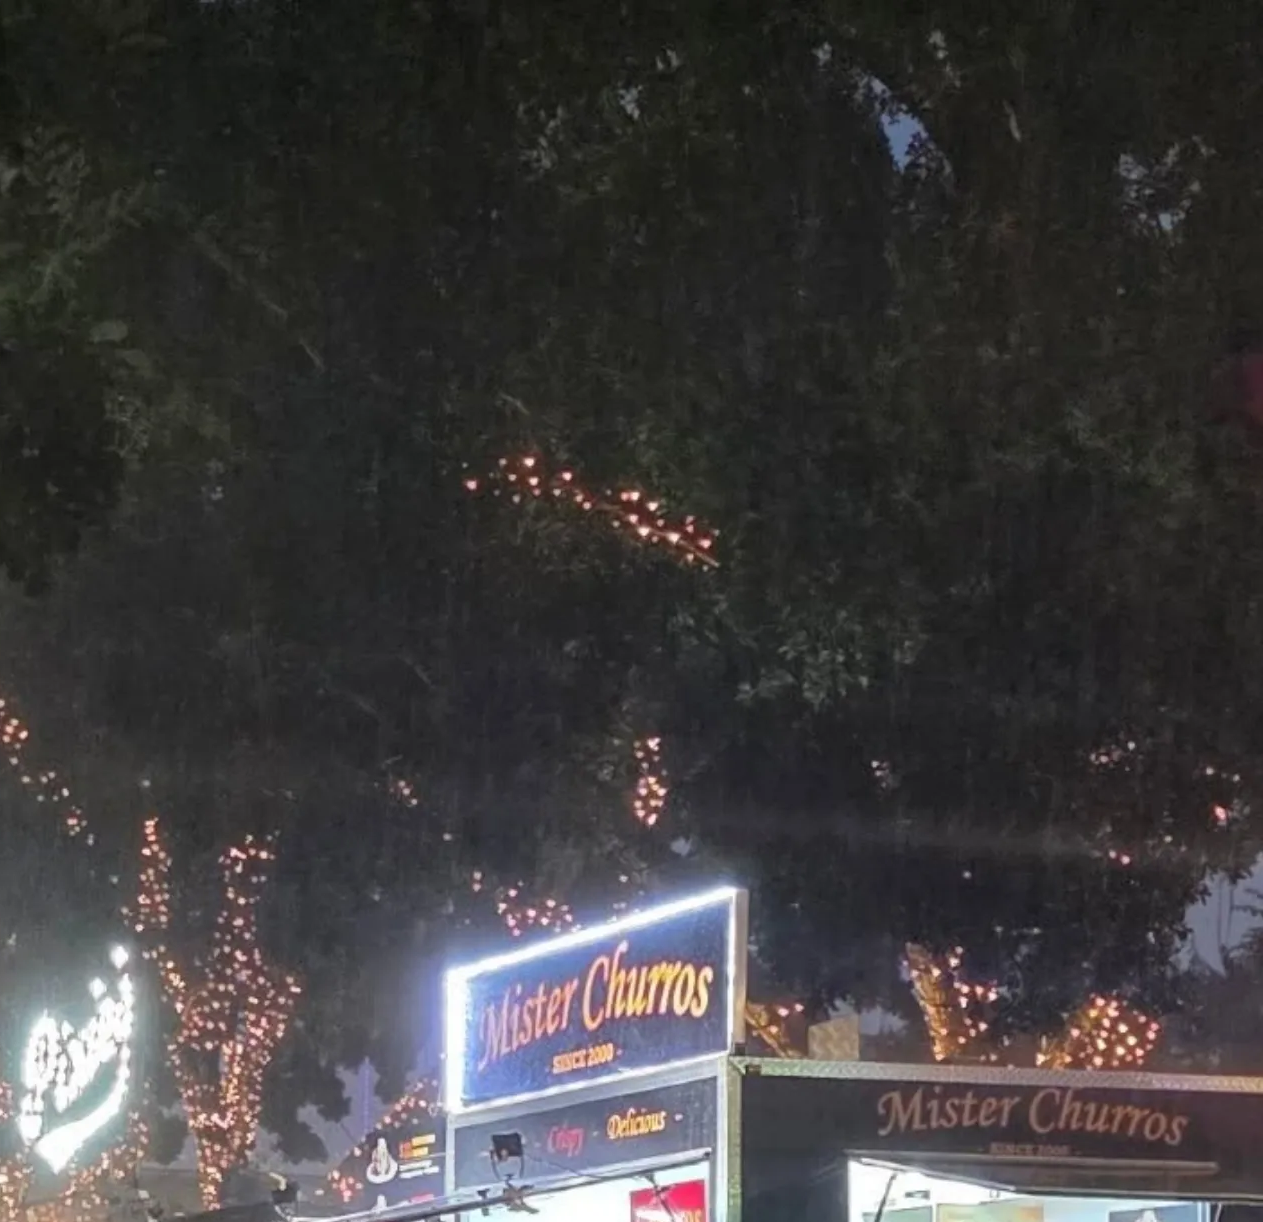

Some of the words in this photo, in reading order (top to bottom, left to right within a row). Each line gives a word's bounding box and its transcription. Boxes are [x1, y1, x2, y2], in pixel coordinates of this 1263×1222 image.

[478, 978, 579, 1071] Mister
[583, 940, 714, 1033] Churros
[552, 1049, 587, 1074] SINCE
[607, 1108, 667, 1140] Delicious
[879, 1087, 1021, 1136] Mister
[1029, 1088, 1187, 1145] Churros
